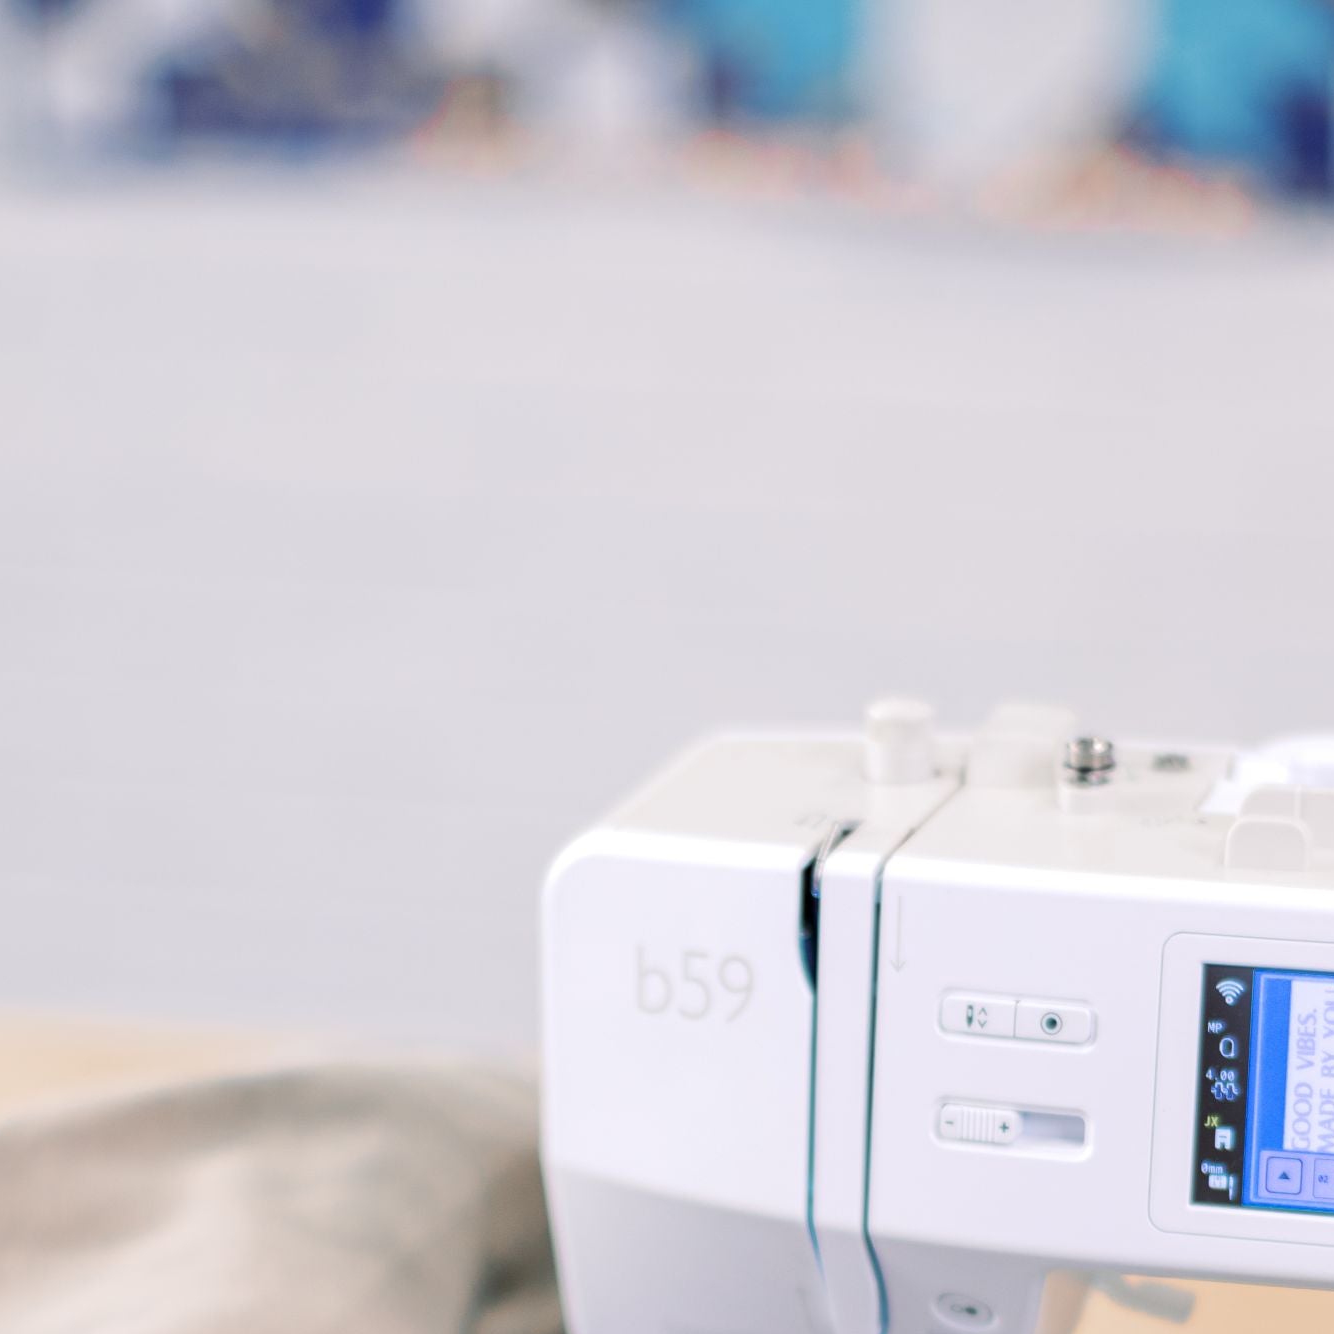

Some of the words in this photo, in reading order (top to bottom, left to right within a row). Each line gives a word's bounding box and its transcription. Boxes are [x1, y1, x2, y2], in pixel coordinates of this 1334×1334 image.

[634, 942, 755, 1024] b59
[1207, 1022, 1223, 1034] MP
[1296, 1008, 1318, 1071] VIBES.
[1205, 1069, 1235, 1082] 4.00
[1203, 1115, 1219, 1128] JX
[1291, 1082, 1314, 1150] GOOD
[1318, 1175, 1329, 1184] 02
